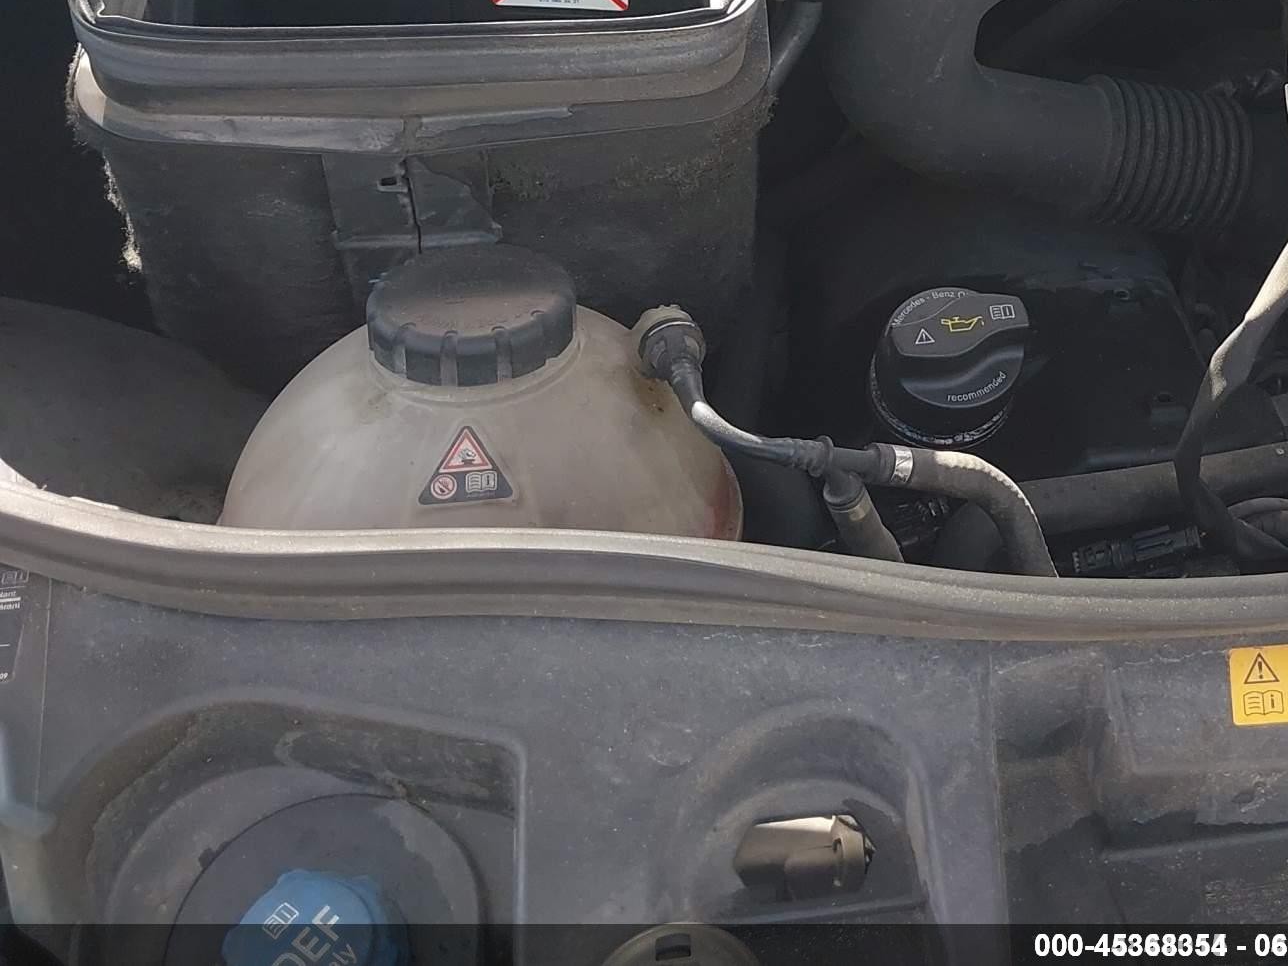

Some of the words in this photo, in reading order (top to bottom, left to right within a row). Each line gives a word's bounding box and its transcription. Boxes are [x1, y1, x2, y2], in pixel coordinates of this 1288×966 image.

[891, 296, 926, 327] Mercedes
[932, 290, 955, 299] Benz
[947, 371, 1007, 402] recommended
